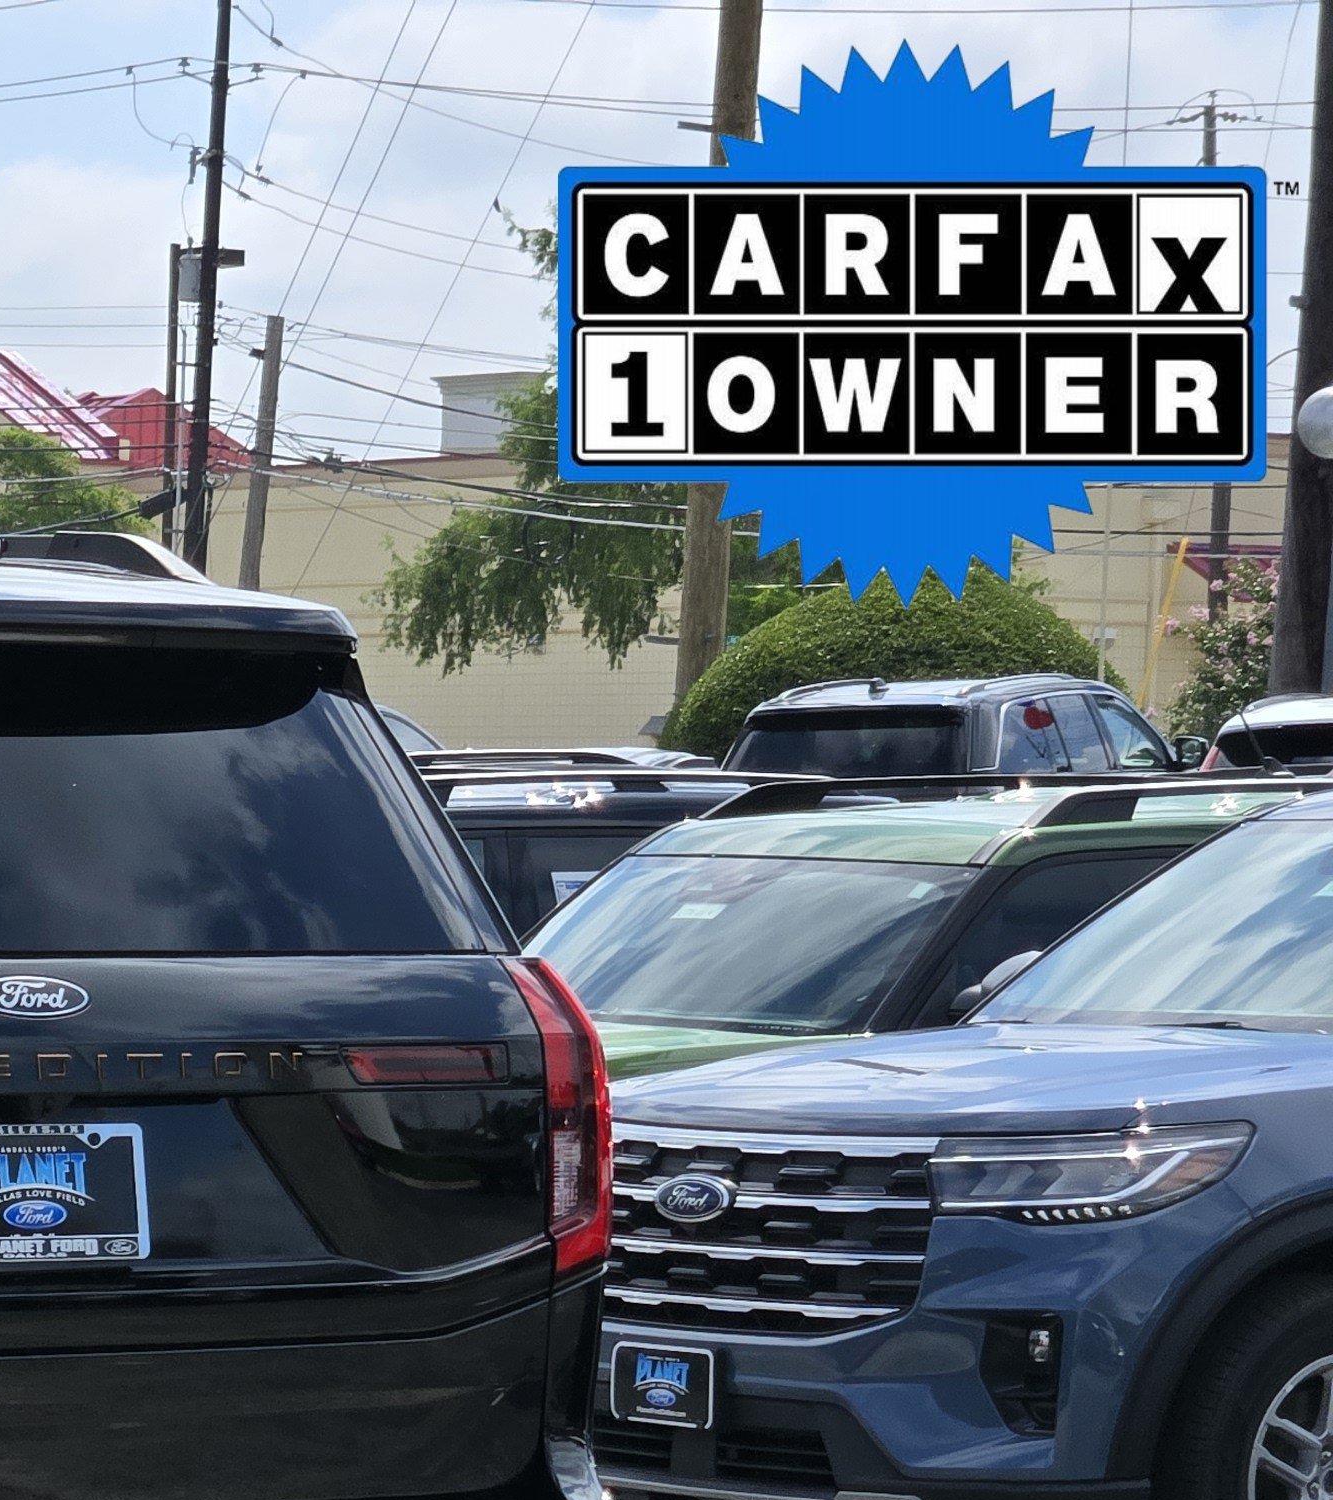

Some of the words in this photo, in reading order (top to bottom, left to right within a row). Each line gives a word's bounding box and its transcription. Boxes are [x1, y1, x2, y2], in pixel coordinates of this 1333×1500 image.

[0, 980, 68, 1010] Ford
[26, 1190, 53, 1198] LOVE
[56, 1192, 86, 1207] FIELD
[667, 1184, 709, 1206] Ford
[15, 1203, 54, 1224] Ford
[50, 1238, 99, 1255] FORD
[636, 1352, 690, 1390] PLANET
